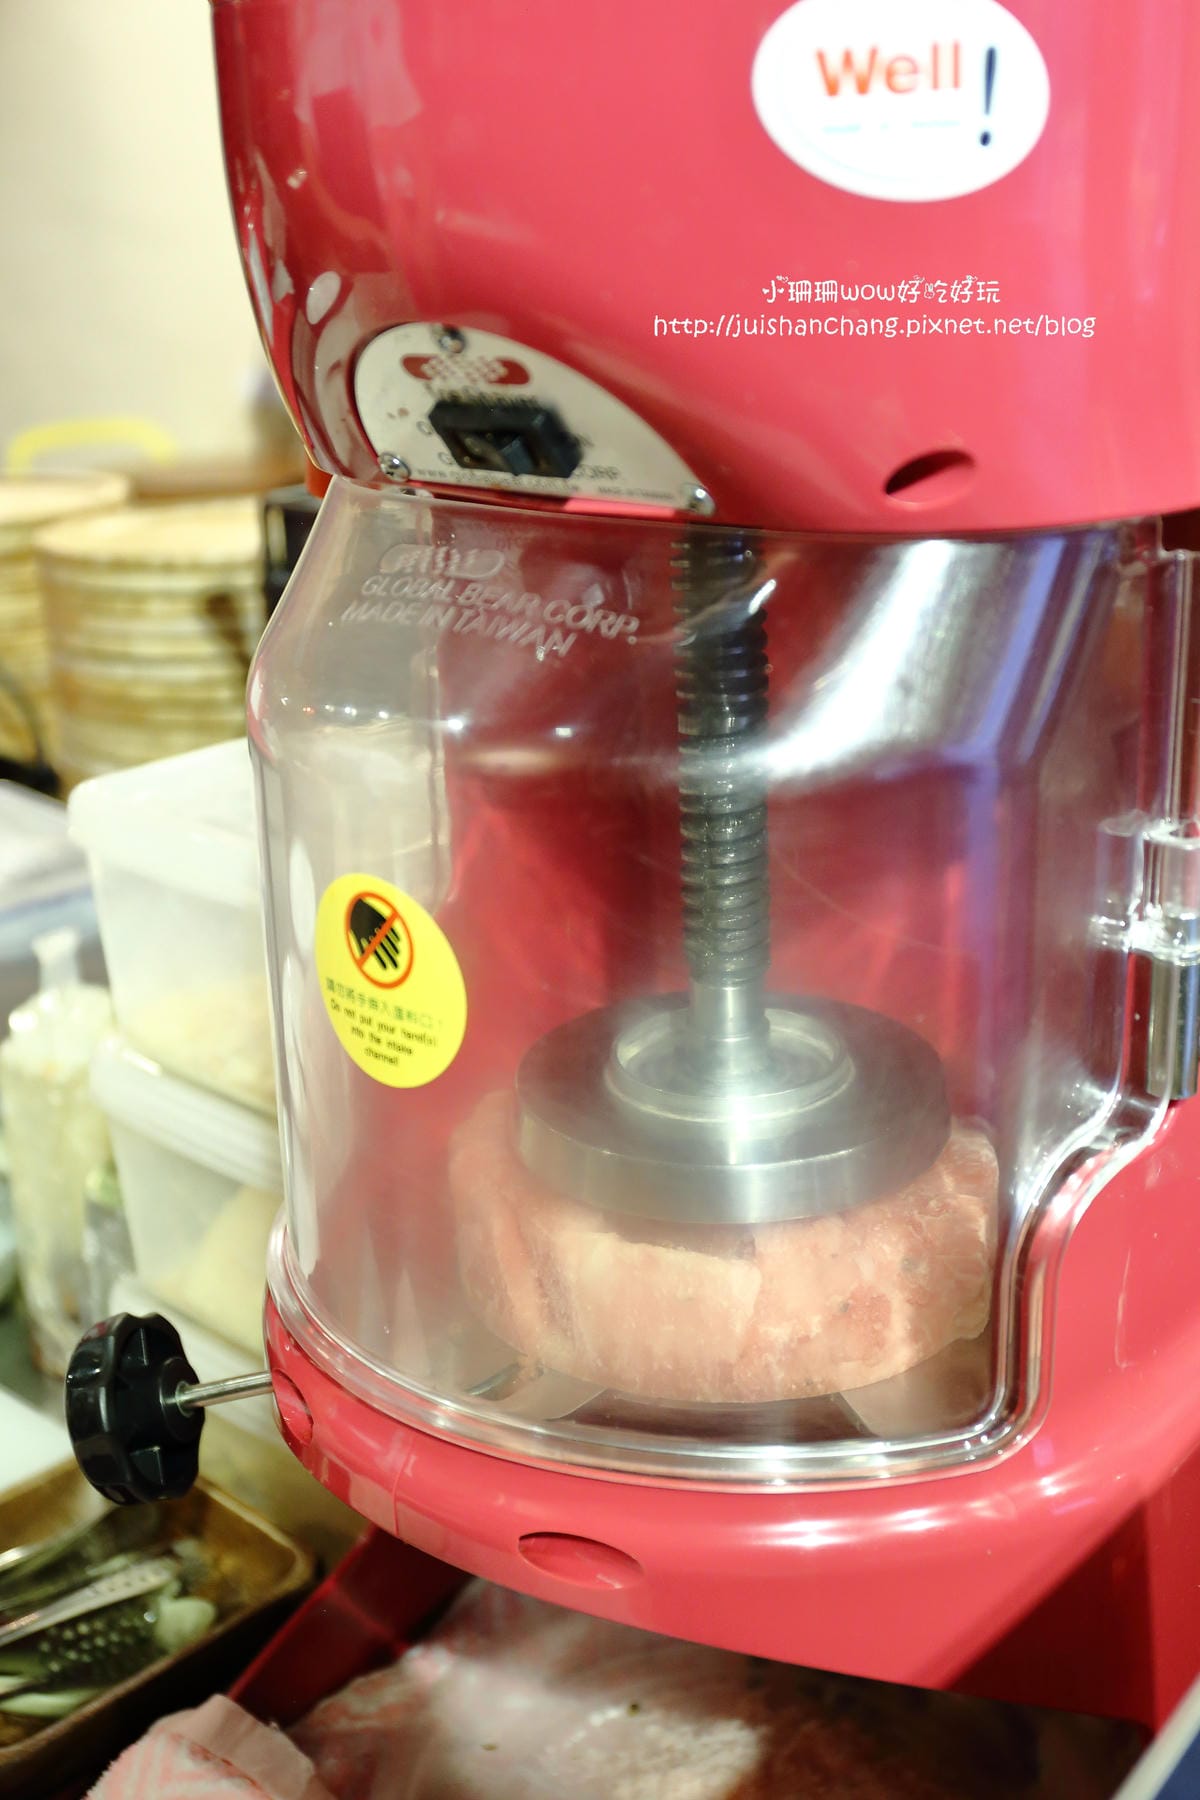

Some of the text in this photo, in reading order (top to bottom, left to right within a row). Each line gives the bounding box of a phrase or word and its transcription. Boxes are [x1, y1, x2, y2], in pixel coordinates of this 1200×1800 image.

[361, 575, 455, 602] GLOBAL
[340, 600, 578, 657] MADE IN TAIWAN
[359, 1015, 372, 1026] put
[377, 1022, 396, 1034] your
[369, 1032, 382, 1045] the
